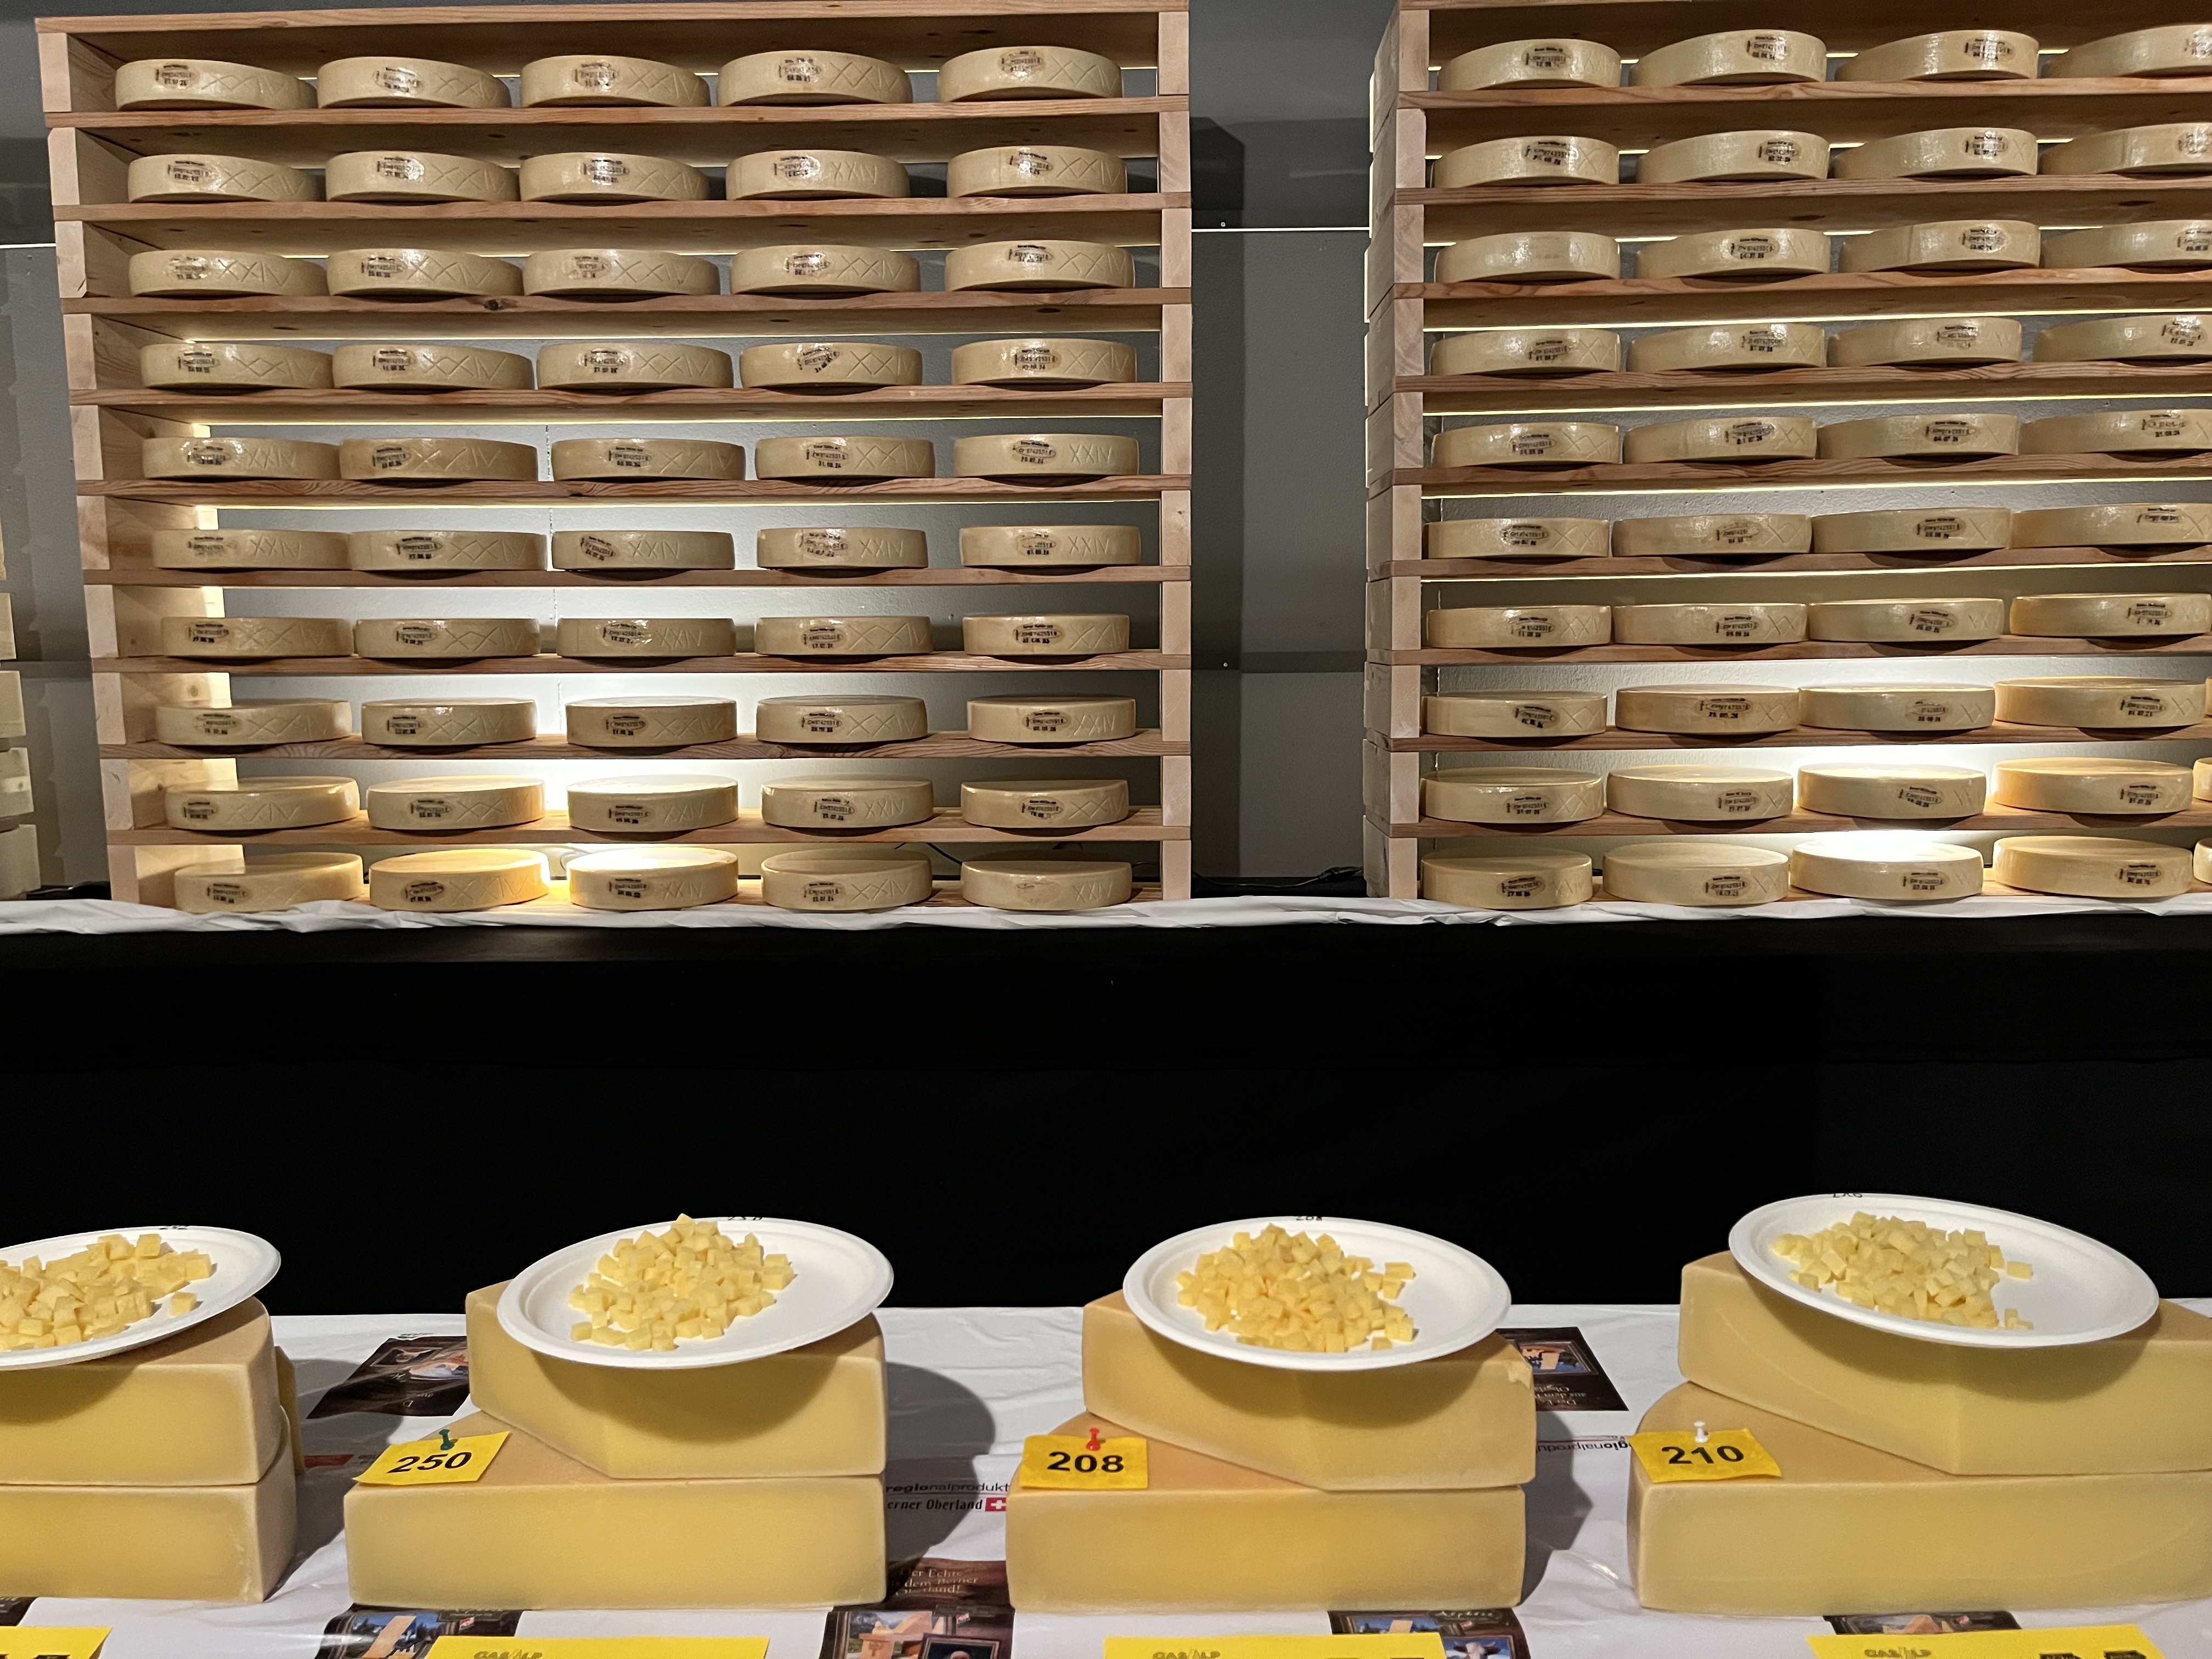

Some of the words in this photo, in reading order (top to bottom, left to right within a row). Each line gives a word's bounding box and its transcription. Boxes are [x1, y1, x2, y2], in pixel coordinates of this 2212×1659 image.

[386, 1452, 472, 1474] 250
[1047, 1451, 1125, 1473] 208
[1661, 1446, 1744, 1465] 210
[887, 1500, 922, 1510] erner
[926, 1499, 983, 1510] Oberland
